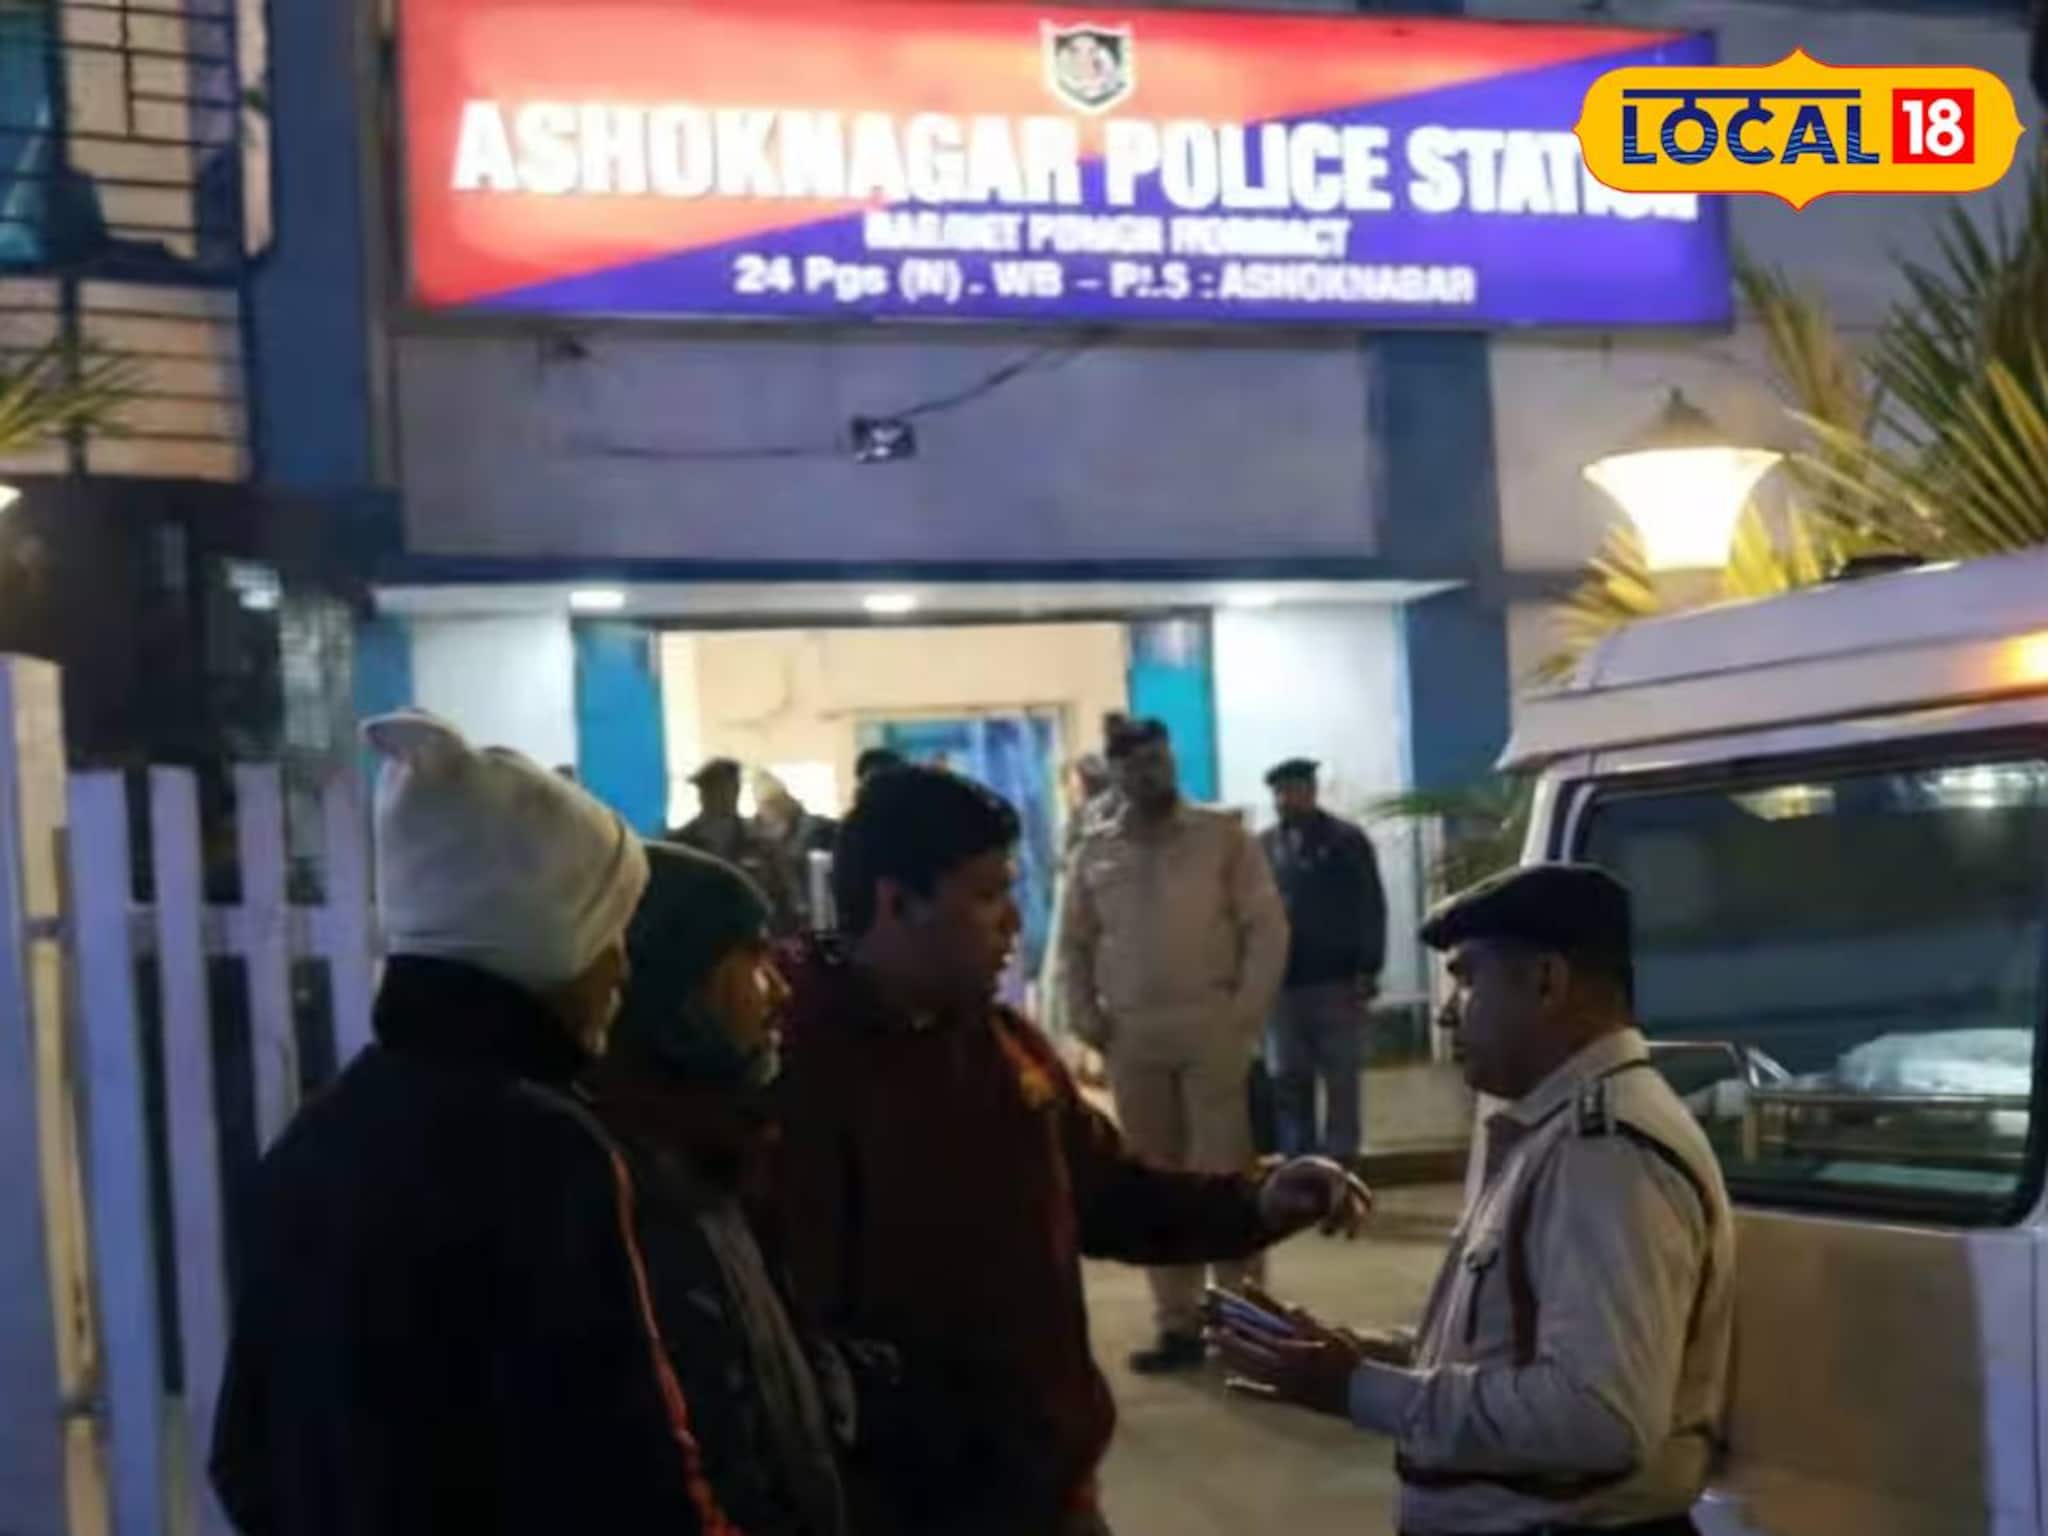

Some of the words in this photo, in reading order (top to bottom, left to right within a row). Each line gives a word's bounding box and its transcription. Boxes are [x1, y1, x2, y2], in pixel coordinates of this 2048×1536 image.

[452, 99, 1080, 206] ASHOKNAGAR
[1104, 119, 1393, 212] POLICE
[1406, 126, 1699, 222] STAT
[734, 254, 794, 293] 24
[804, 255, 888, 302] Pgs
[991, 260, 1064, 297] WB
